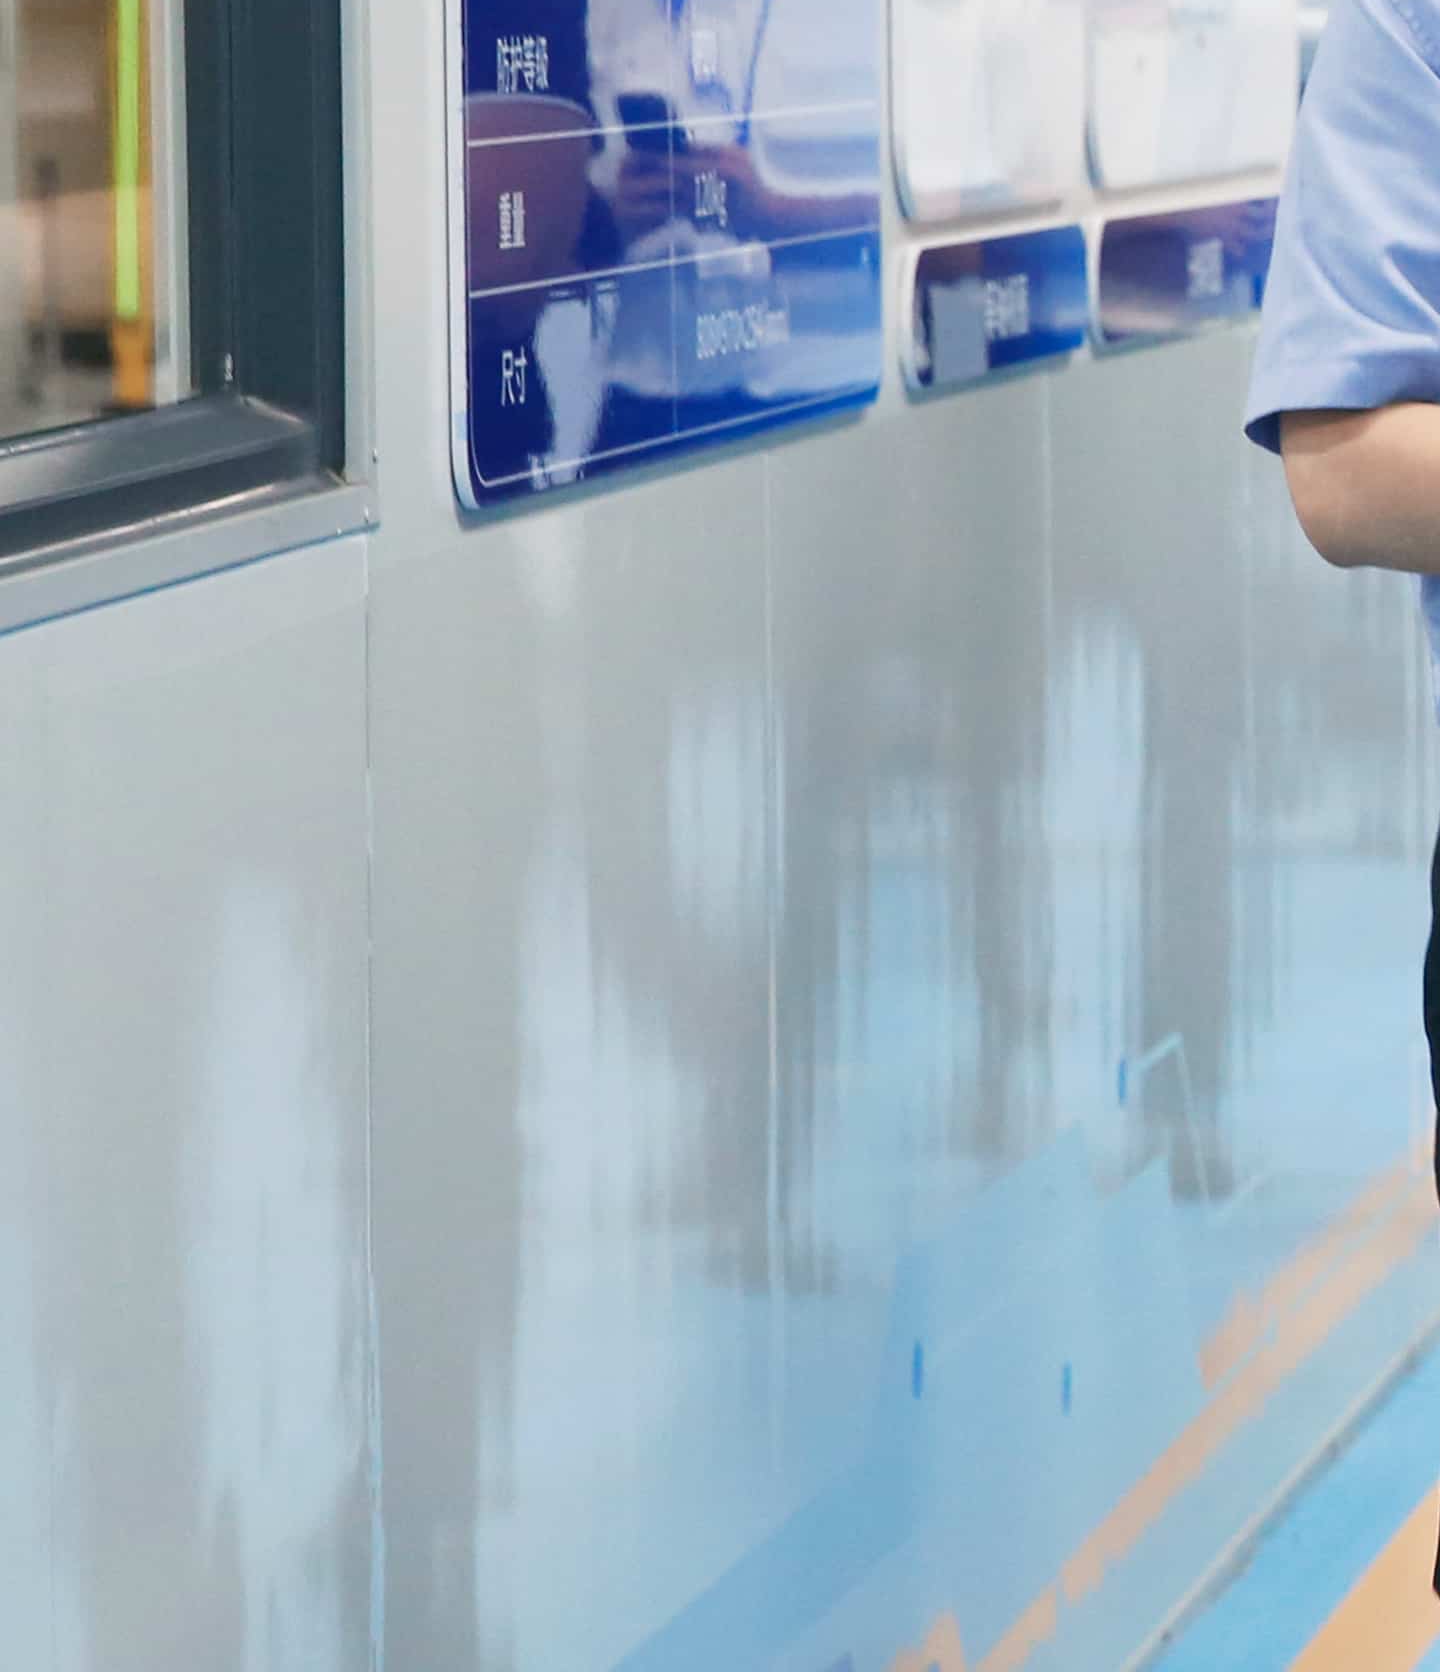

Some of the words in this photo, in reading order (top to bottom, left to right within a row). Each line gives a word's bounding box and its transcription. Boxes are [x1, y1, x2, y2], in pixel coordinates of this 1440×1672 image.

[497, 35, 550, 96] 防护等级
[501, 347, 529, 408] 尺寸
